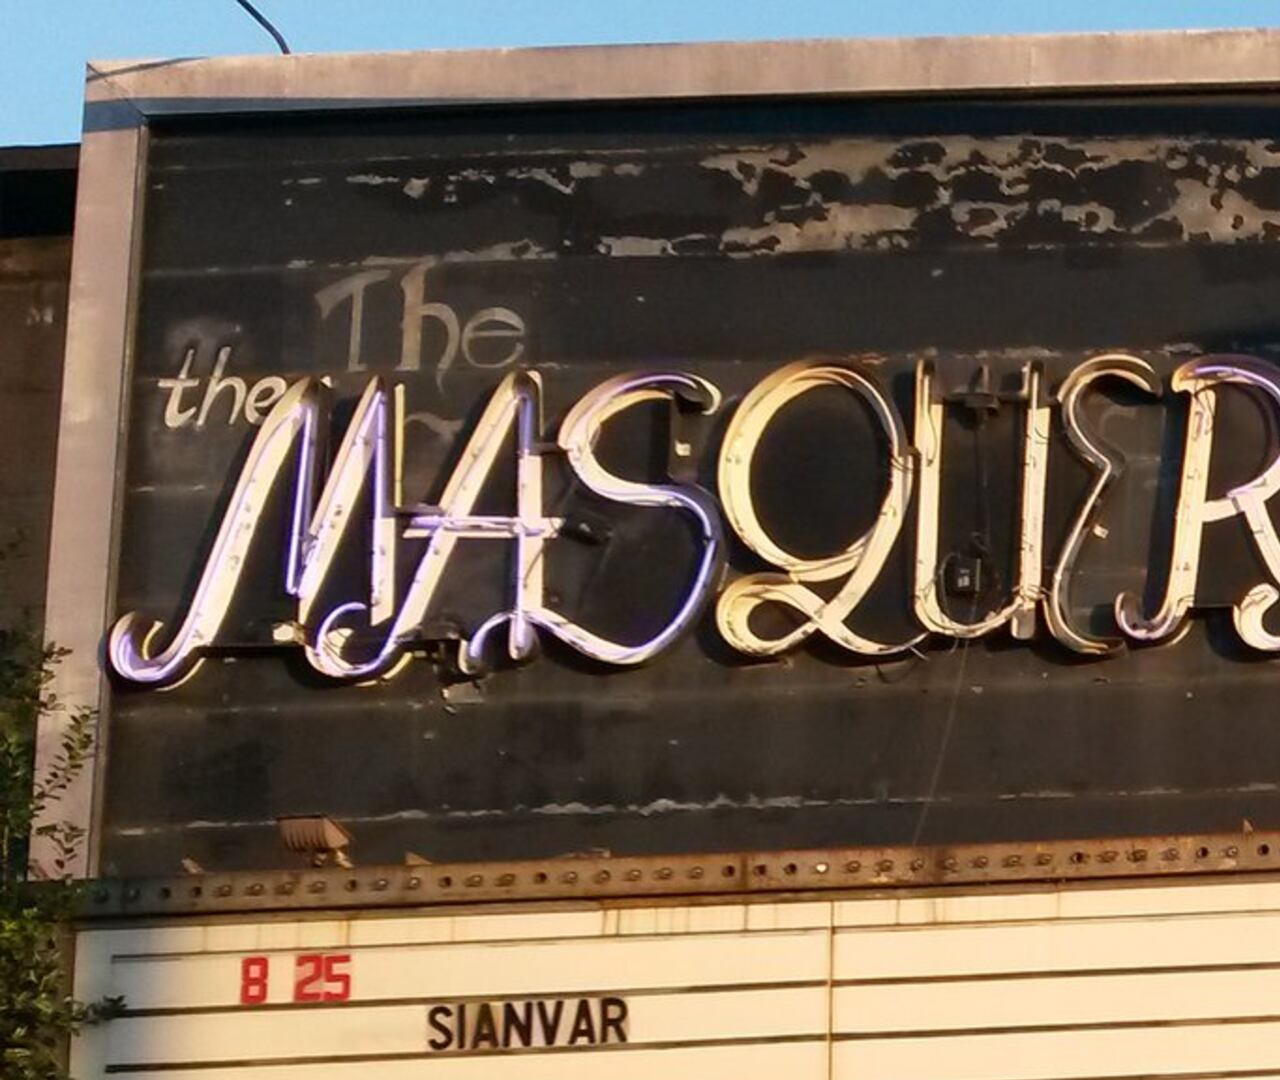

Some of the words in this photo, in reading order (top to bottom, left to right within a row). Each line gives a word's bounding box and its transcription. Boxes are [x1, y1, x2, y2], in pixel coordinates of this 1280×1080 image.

[314, 254, 526, 396] The
[157, 346, 290, 430] the
[240, 956, 268, 1004] 8
[294, 953, 352, 1002] 25
[427, 997, 629, 1050] SIANVAR
